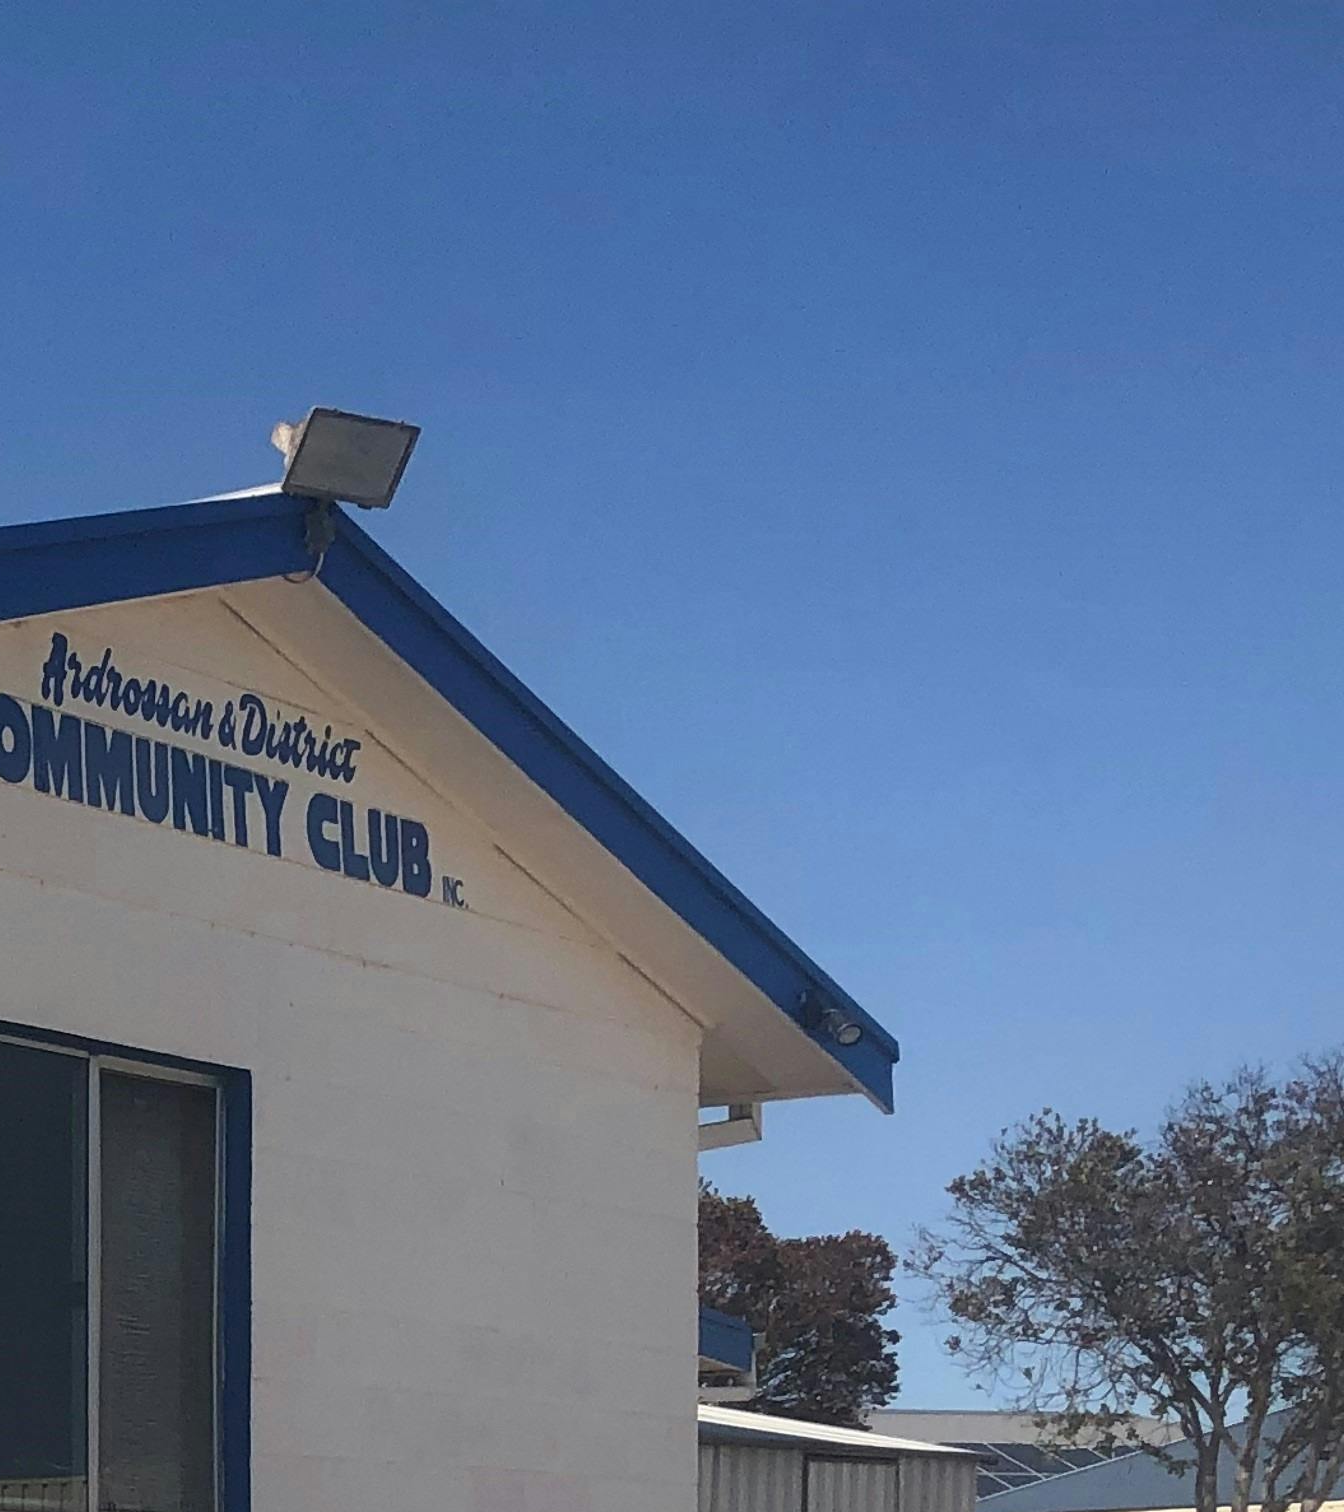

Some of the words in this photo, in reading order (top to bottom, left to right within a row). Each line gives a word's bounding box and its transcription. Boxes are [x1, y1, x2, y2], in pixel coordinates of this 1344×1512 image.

[42, 632, 214, 741] Ardrossan
[219, 695, 237, 747] &
[239, 693, 362, 783] District
[307, 792, 433, 898] CLUB
